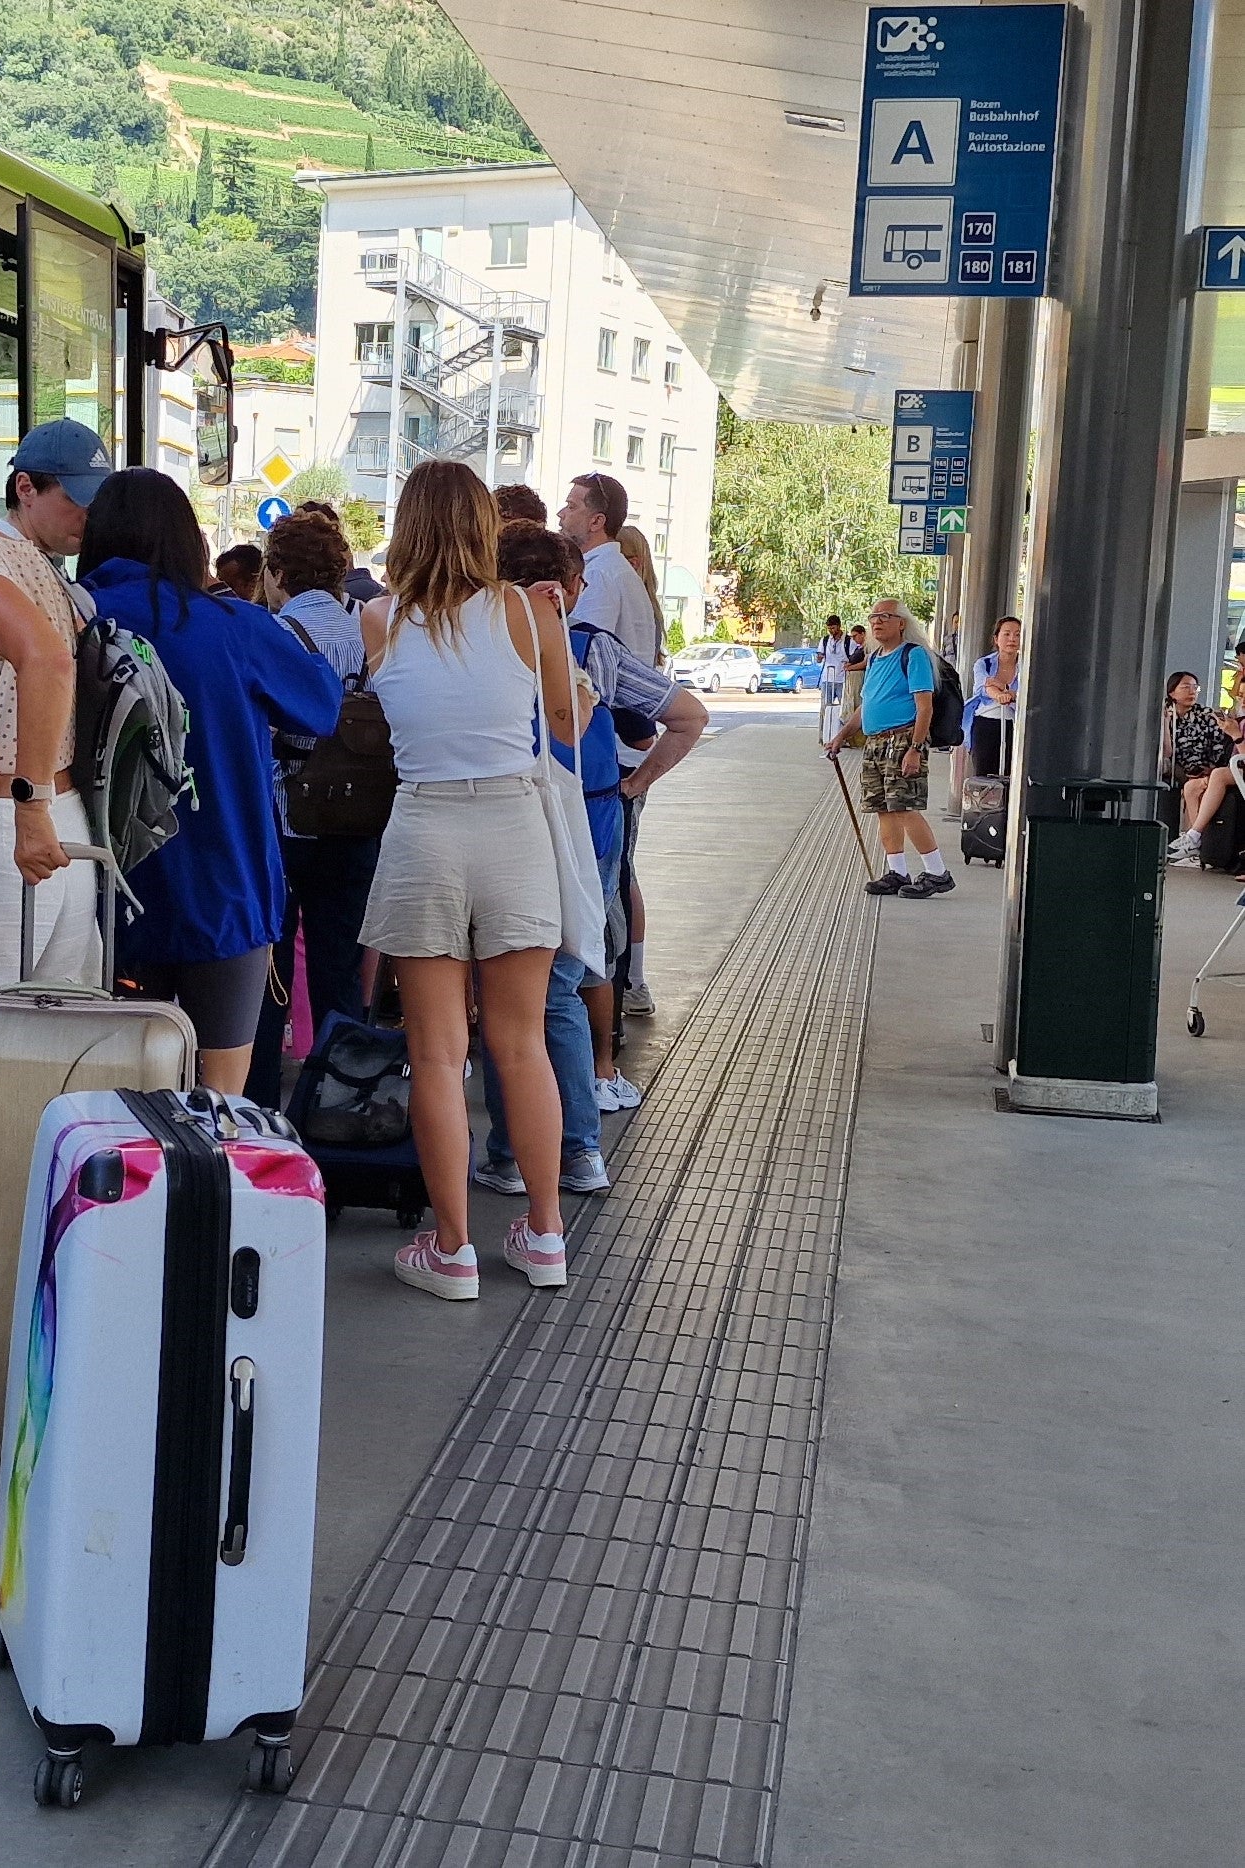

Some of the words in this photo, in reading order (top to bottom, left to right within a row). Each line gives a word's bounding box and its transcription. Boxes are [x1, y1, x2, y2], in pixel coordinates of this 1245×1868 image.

[970, 100, 1001, 109] Bozen
[969, 110, 1040, 122] Busbahnhof
[890, 120, 935, 165] A
[968, 132, 1009, 142] Bolzano
[967, 141, 1046, 153] Autostazione
[966, 222, 992, 237] 170
[964, 260, 990, 274] 180
[1007, 260, 1033, 274] 181
[907, 435, 920, 452] B
[909, 511, 918, 522] B
